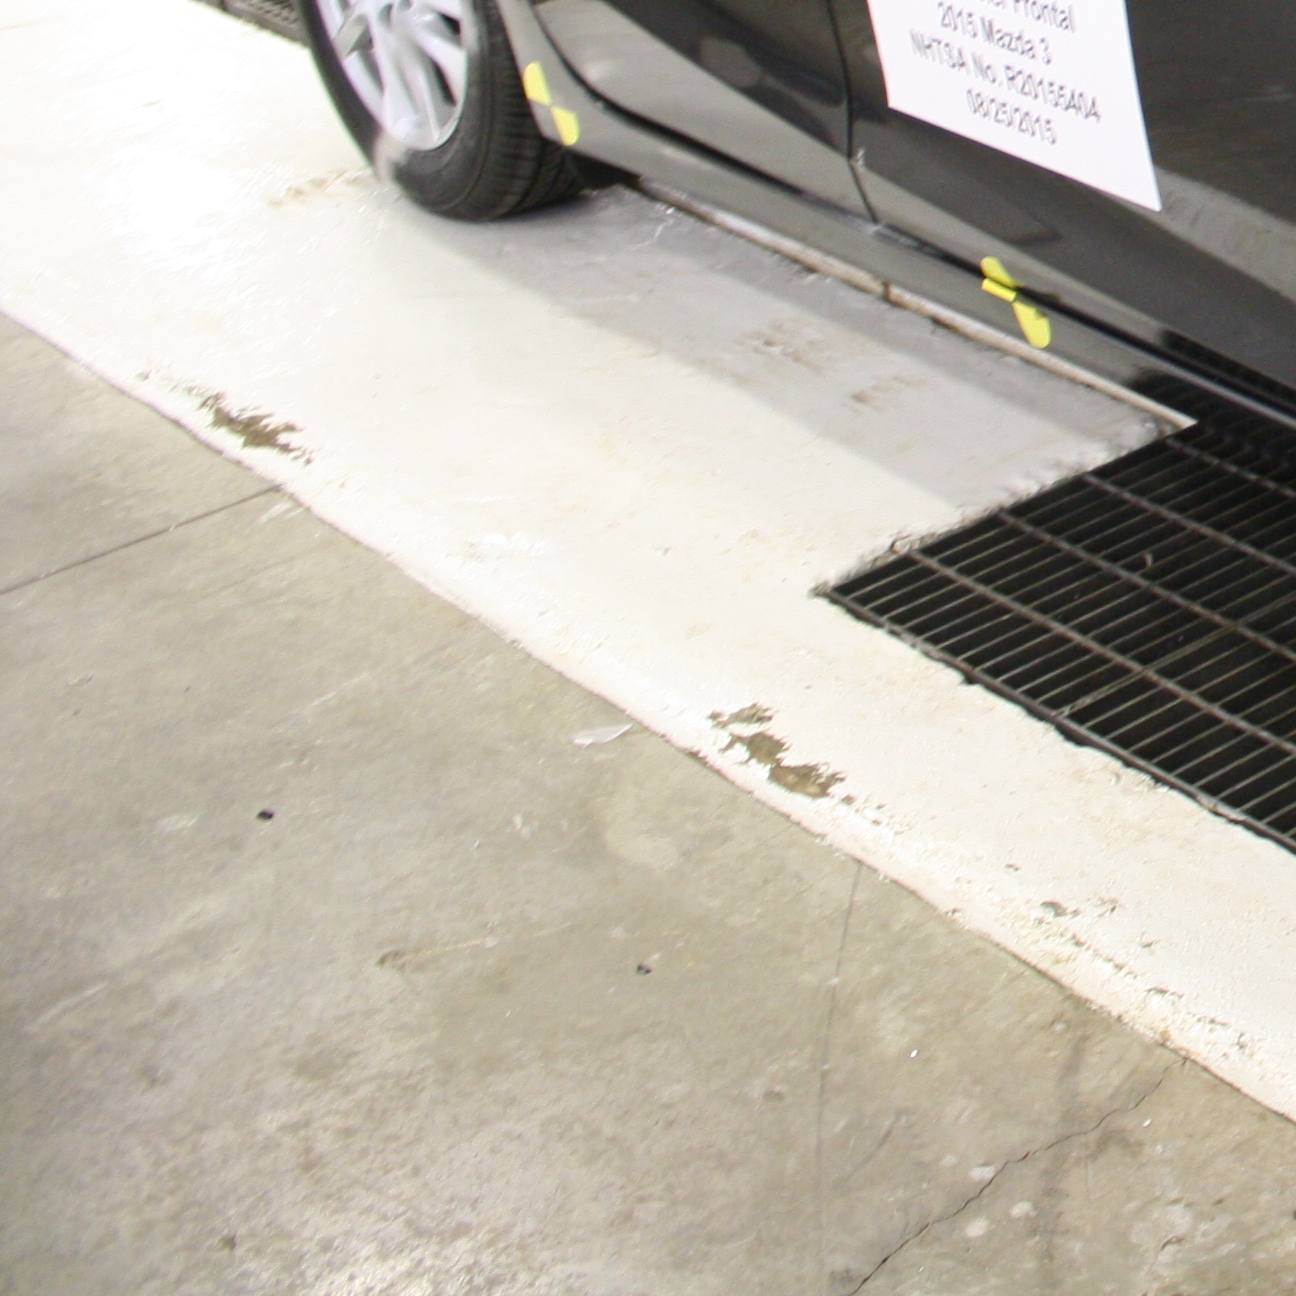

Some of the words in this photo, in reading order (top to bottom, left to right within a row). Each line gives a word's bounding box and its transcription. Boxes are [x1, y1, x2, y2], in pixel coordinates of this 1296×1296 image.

[938, 1, 978, 38] 2015
[980, 16, 1037, 61] Mazda
[1039, 37, 1052, 65] 3
[909, 28, 971, 76] NHTSA
[1004, 64, 1100, 124] R20155404
[966, 88, 1057, 145] 08/25/2015
